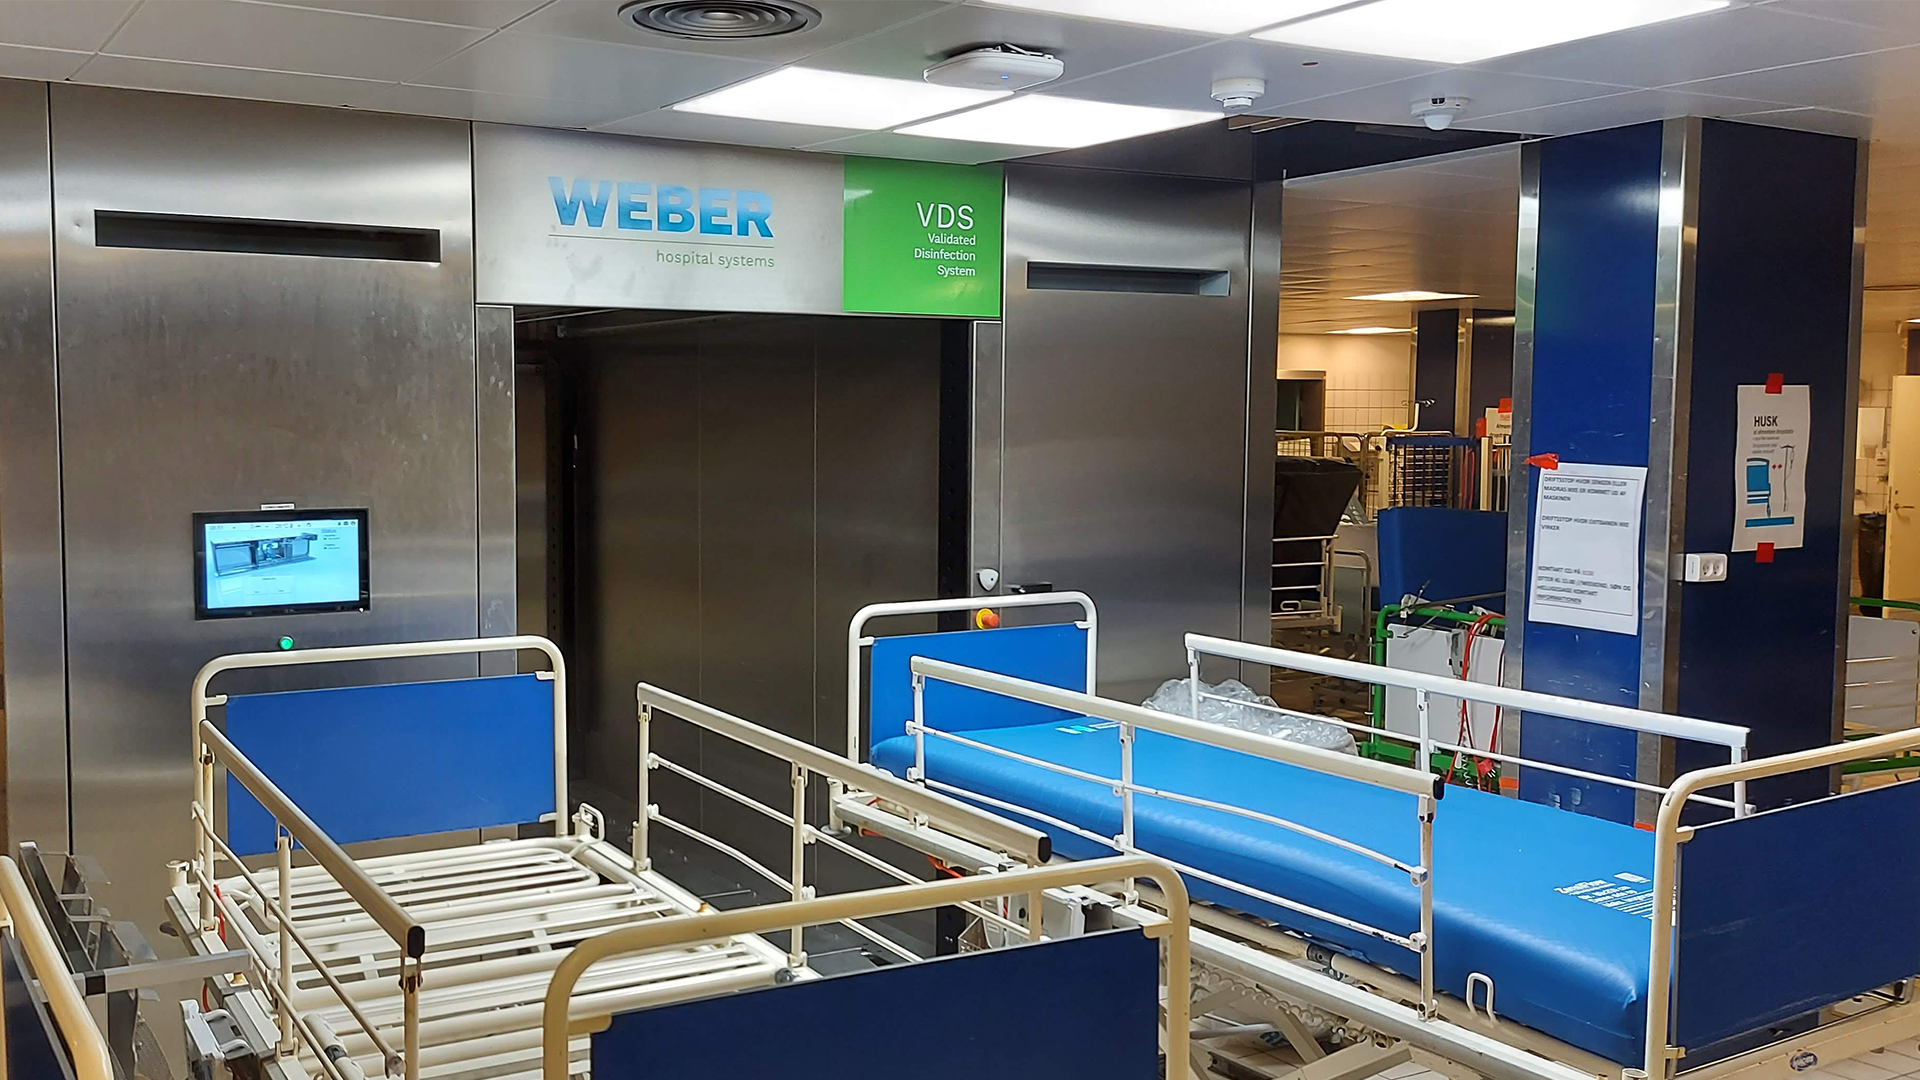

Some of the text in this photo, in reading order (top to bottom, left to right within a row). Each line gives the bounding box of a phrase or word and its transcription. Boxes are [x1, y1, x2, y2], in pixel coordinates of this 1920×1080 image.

[548, 176, 774, 238] WEBER
[916, 202, 974, 230] VDS
[928, 232, 976, 246] Validated
[656, 250, 775, 269] hospital systems
[914, 248, 976, 261] Disinfection
[937, 264, 976, 278] System
[1754, 416, 1778, 427] HUSK
